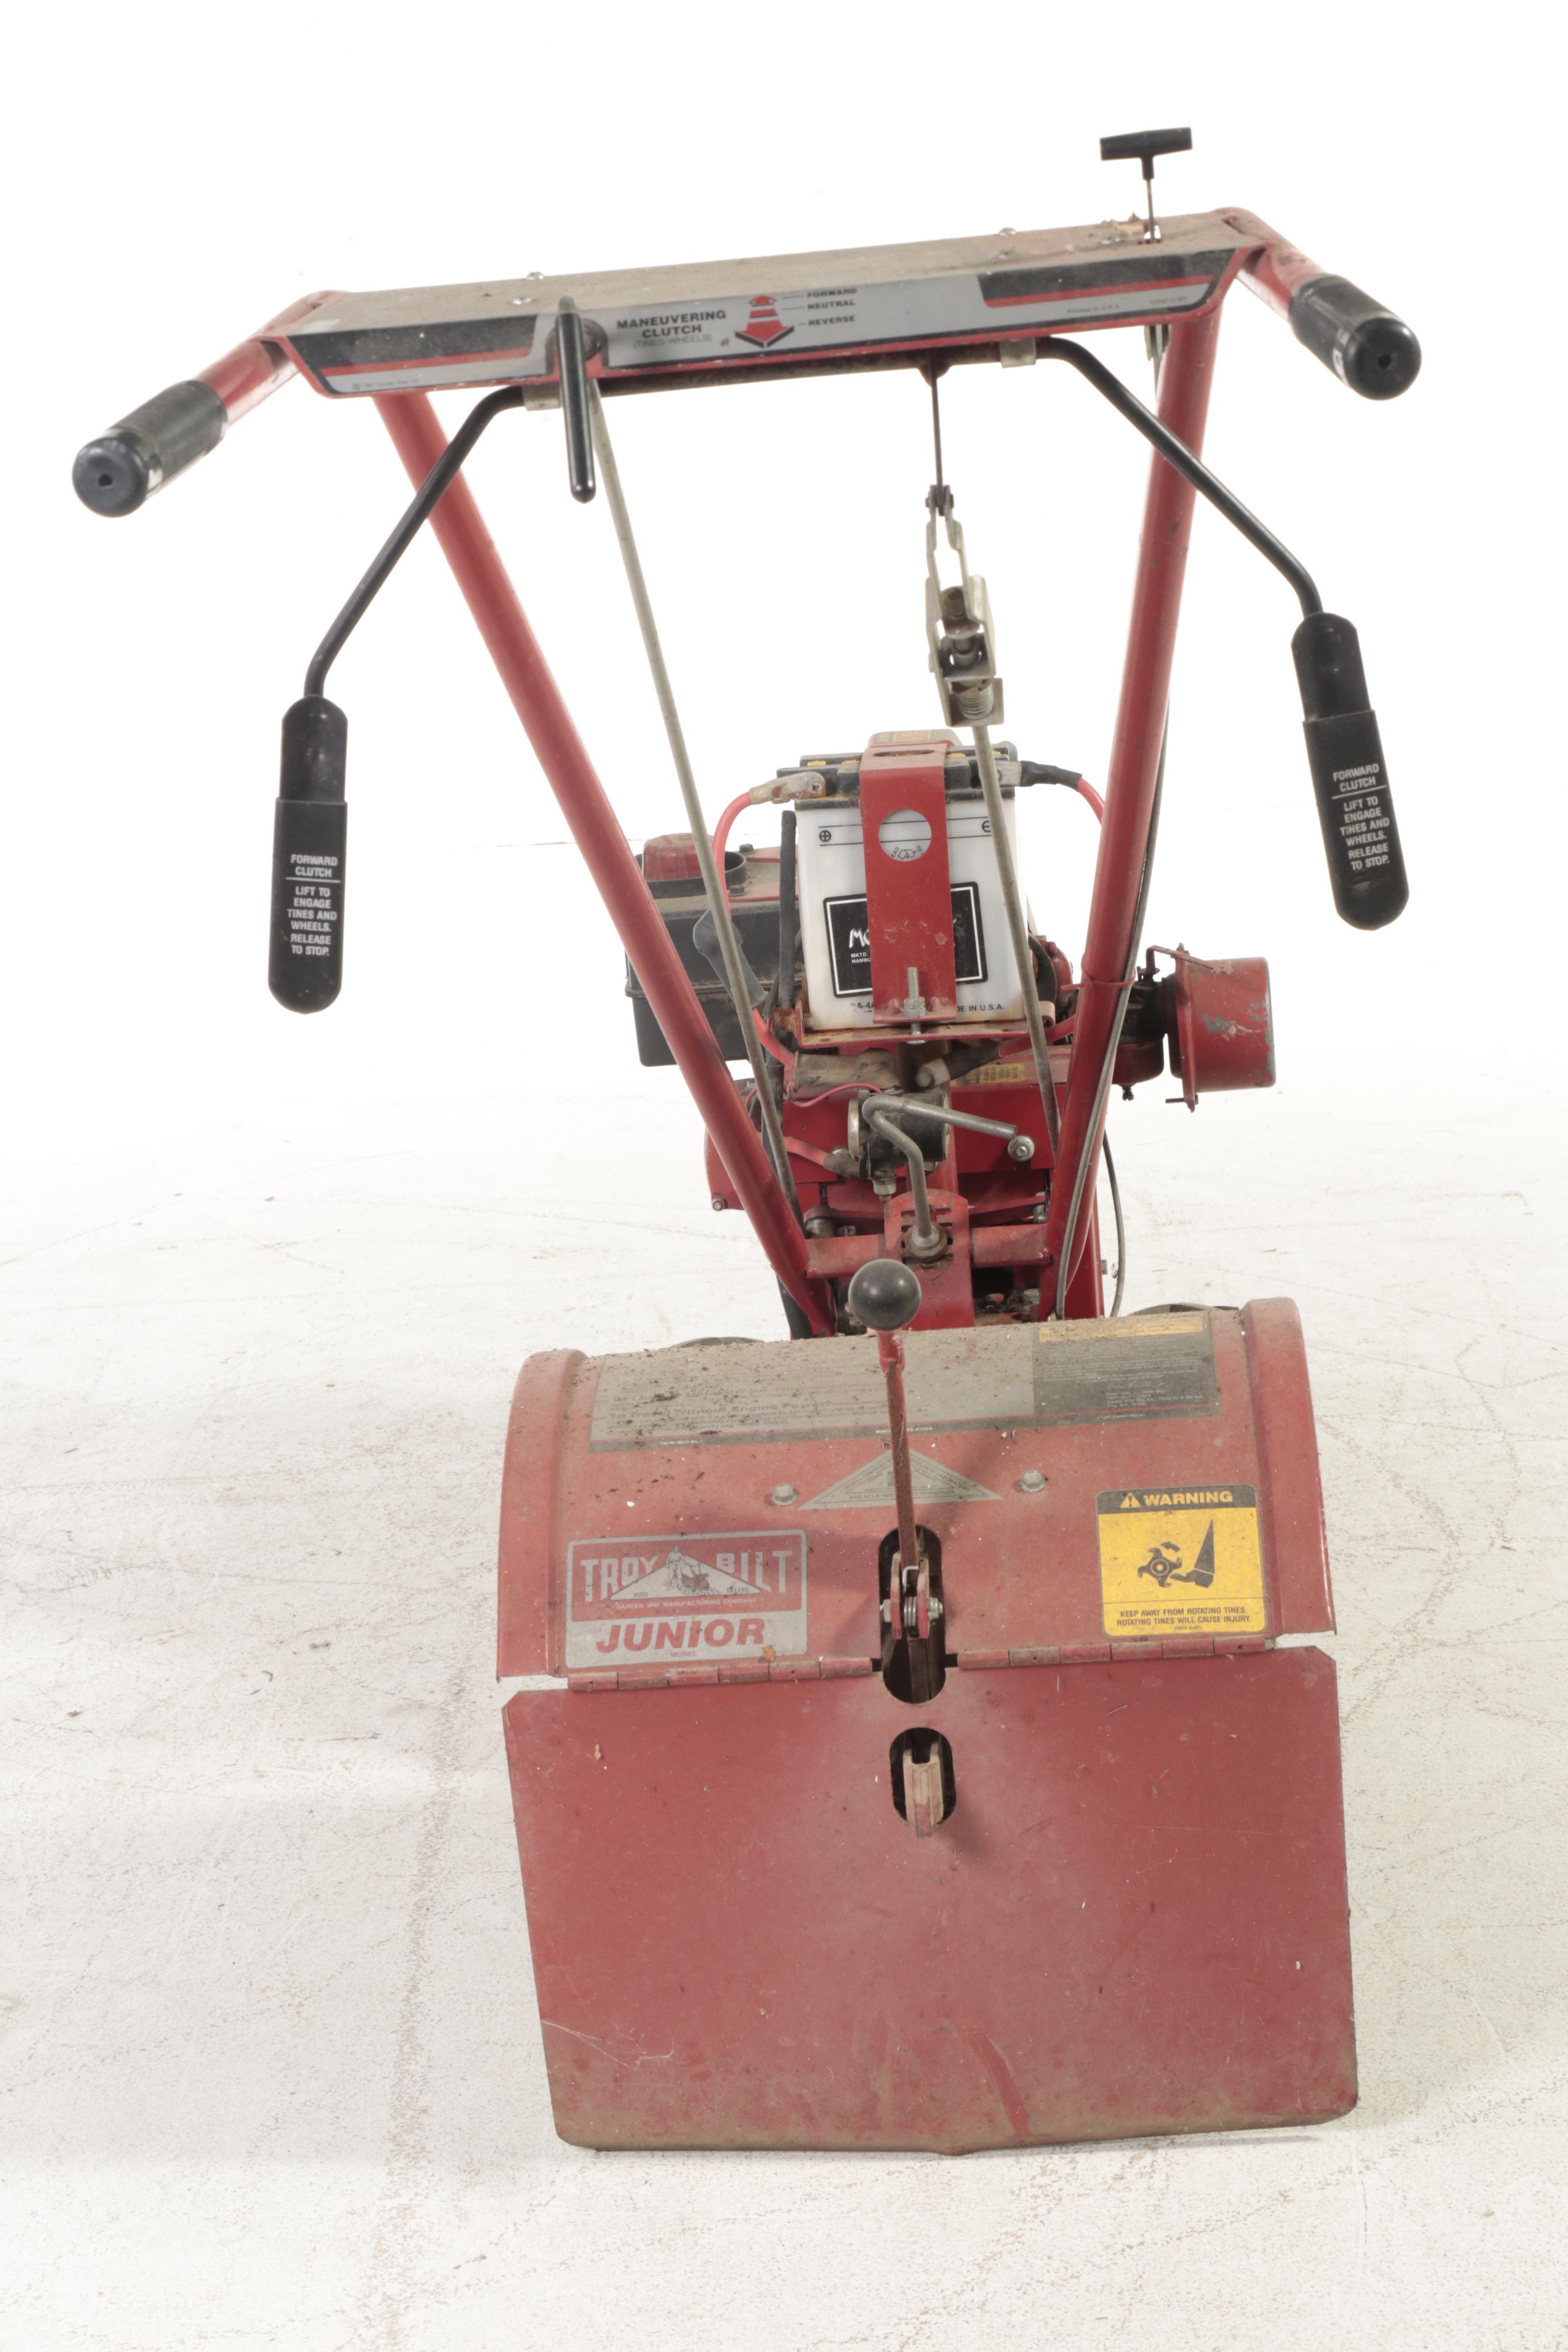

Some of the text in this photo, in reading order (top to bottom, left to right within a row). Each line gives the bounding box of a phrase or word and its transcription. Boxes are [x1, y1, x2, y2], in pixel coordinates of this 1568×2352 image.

[807, 288, 857, 298] FORWARD
[807, 299, 855, 310] NEUTRAL
[616, 309, 727, 329] MANEUVERING
[808, 315, 855, 326] REVERSE
[642, 324, 703, 339] CLUTCH
[1332, 763, 1380, 782] FORWARD
[1340, 776, 1376, 792] CLUTCH
[1344, 796, 1378, 811] LIFT TO
[1344, 807, 1382, 824] ENGAGE
[1340, 818, 1390, 836] TINES AND
[1346, 831, 1387, 847] WHEELS.
[890, 847, 900, 857] EAD
[1348, 843, 1389, 860] RELEASE
[290, 854, 338, 866] FORWARD
[1351, 855, 1390, 871] TO STOP.
[295, 866, 332, 877] CLUTCH
[295, 886, 331, 897] LIFT TO
[293, 897, 331, 909] ENGAGE
[287, 909, 337, 920] TINES AND
[290, 920, 331, 932] WHEELS.
[290, 933, 331, 944] RELEASE
[292, 945, 329, 956] TO STOP.
[1144, 1491, 1233, 1506] WARNING
[580, 1550, 793, 1603] TROY BILT
[616, 1602, 644, 1611] GARDEN
[662, 1598, 721, 1608] MANUFACTURING
[1187, 1607, 1221, 1615] ROTATING
[596, 1618, 766, 1654] JUNIOR
